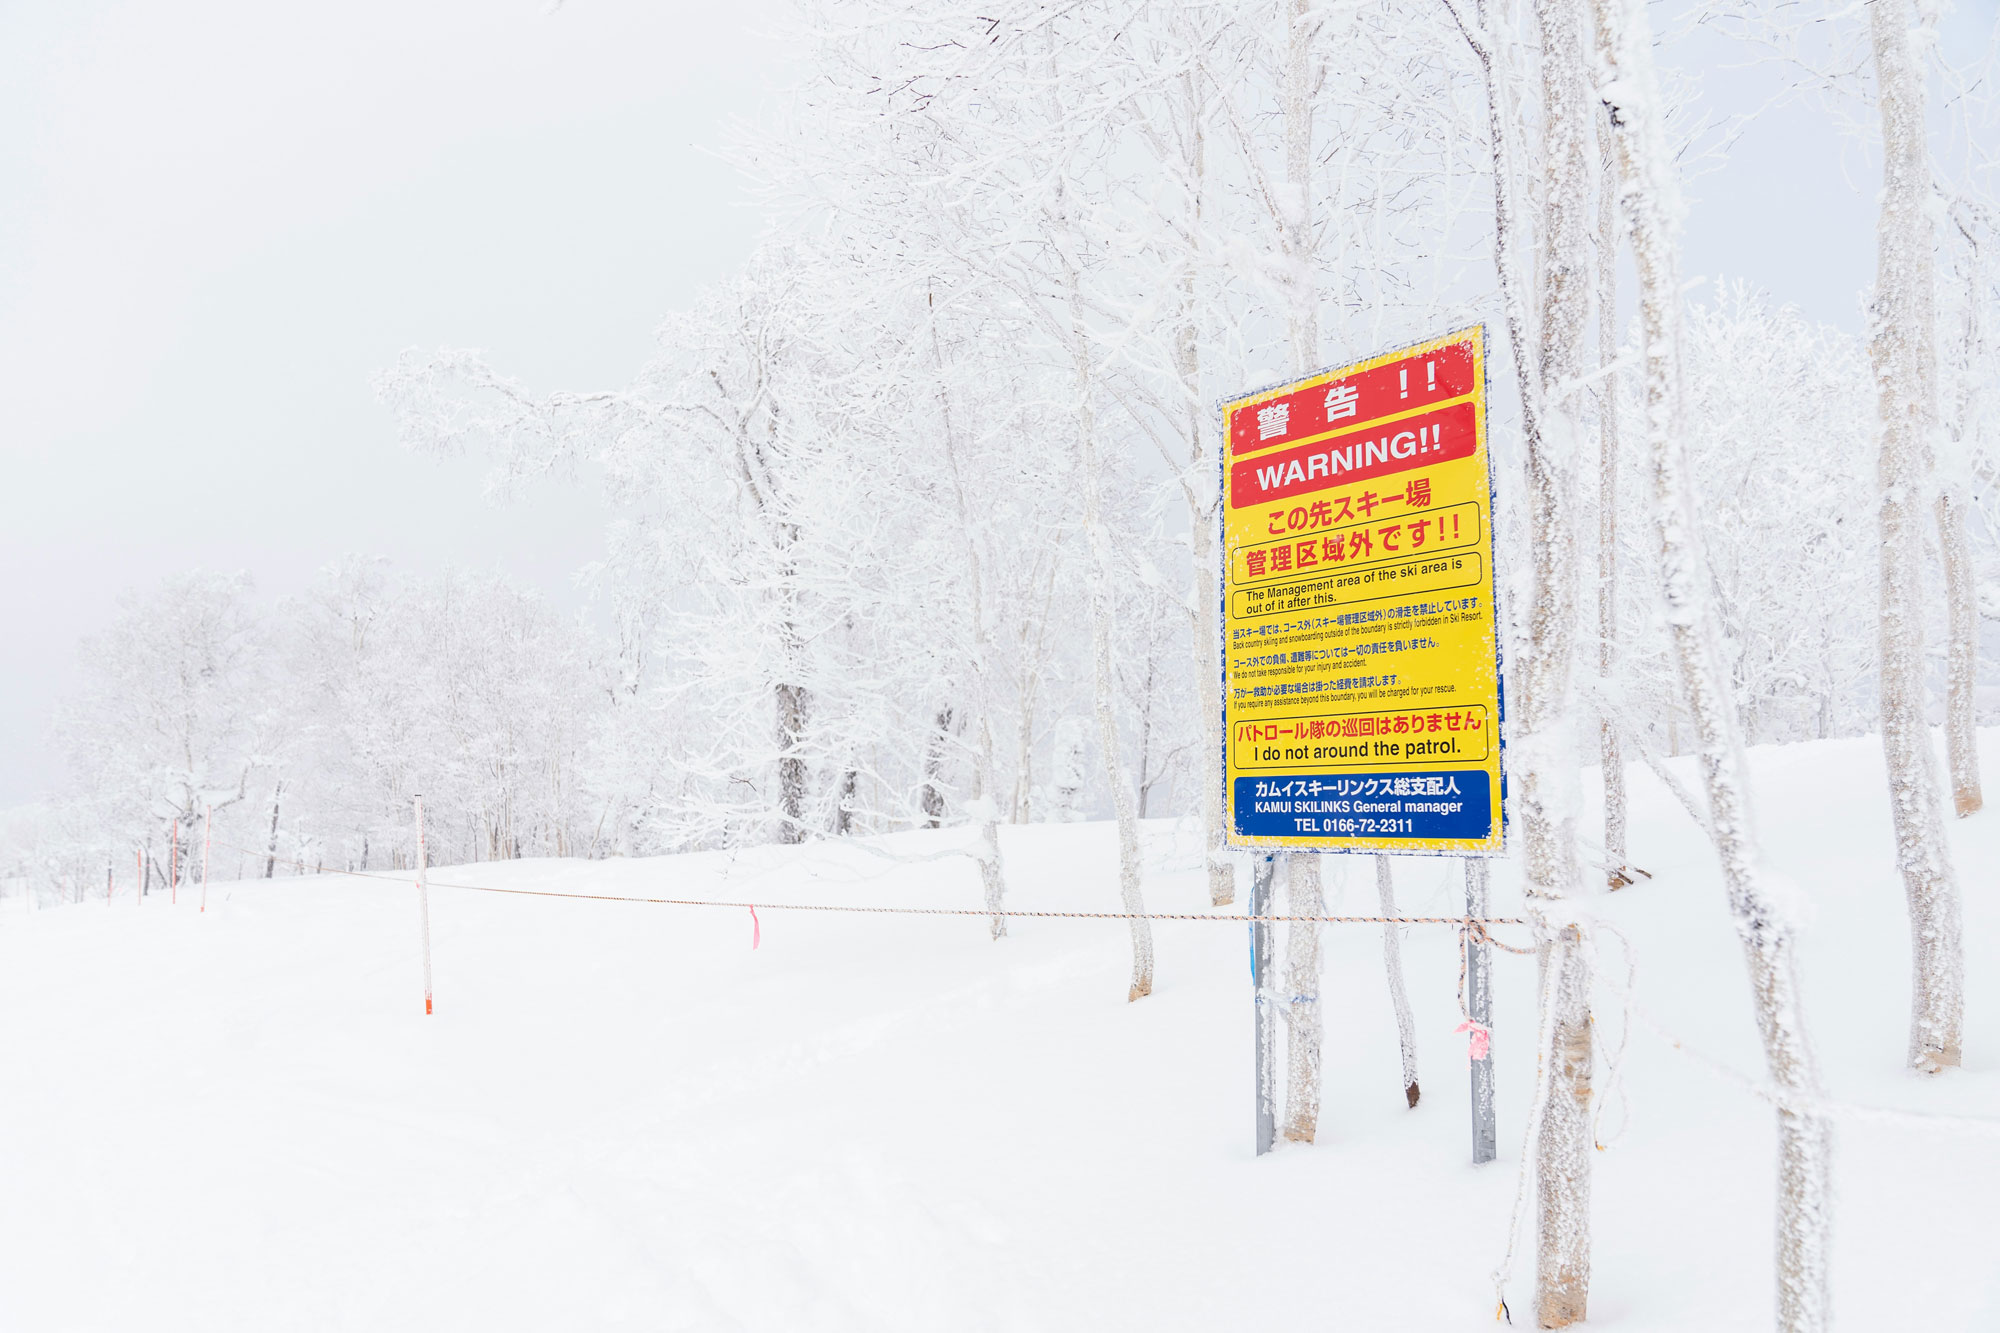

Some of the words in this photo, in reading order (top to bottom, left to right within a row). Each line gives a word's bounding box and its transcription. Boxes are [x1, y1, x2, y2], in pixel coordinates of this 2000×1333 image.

[1256, 424, 1440, 491] WARNING!!
[1267, 478, 1431, 535] この先スキー場
[1246, 513, 1459, 577] 管理区域外です!!
[1246, 590, 1265, 601] The
[1267, 578, 1333, 598] Management
[1336, 575, 1361, 587] area
[1364, 571, 1375, 583] of
[1379, 569, 1397, 581] the
[1400, 564, 1417, 578] ski
[1421, 562, 1447, 575] area
[1452, 558, 1462, 570] is
[1246, 603, 1262, 614] out
[1265, 600, 1275, 611] of
[1278, 599, 1284, 609] it
[1287, 597, 1310, 608] after
[1314, 592, 1337, 604] this.
[1233, 641, 1244, 650] Back
[1245, 639, 1263, 649] country
[1264, 637, 1278, 647] skiing
[1279, 635, 1288, 644] and
[1289, 631, 1324, 643] snowboarding
[1325, 628, 1343, 638] outside
[1351, 626, 1360, 635] the
[1361, 622, 1386, 634] boundary
[1394, 620, 1413, 631] strictly
[1414, 616, 1441, 627] forbidden
[1450, 613, 1460, 623] Ski
[1461, 611, 1482, 621] Resort.
[1233, 671, 1240, 679] We
[1241, 670, 1247, 678] do
[1257, 668, 1266, 677] take
[1267, 665, 1295, 677] responsible
[1304, 663, 1316, 674] your
[1317, 662, 1331, 672] injury
[1332, 660, 1342, 669] and
[1343, 658, 1367, 668] accident.
[1238, 701, 1246, 711] you
[1247, 699, 1263, 710] require
[1264, 699, 1273, 708] any
[1274, 696, 1299, 706] assistance
[1301, 694, 1319, 705] beyond
[1320, 693, 1330, 702] this
[1331, 691, 1357, 703] boundary,
[1358, 691, 1368, 702] you
[1369, 689, 1377, 698] will
[1378, 688, 1386, 698] be
[1387, 686, 1410, 698] charged
[1411, 685, 1419, 695] for
[1420, 686, 1433, 696] your
[1435, 684, 1456, 694] rescue.
[1238, 711, 1481, 742] パトロール隊の巡回はありません
[1255, 746, 1258, 761] I
[1263, 746, 1280, 760] do
[1285, 745, 1309, 760] not
[1313, 741, 1368, 759] around
[1374, 740, 1400, 756] the
[1405, 737, 1461, 759] patrol.
[1255, 776, 1461, 797] カムイスキーリンクス総支配人
[1255, 801, 1292, 813] KAMUI
[1294, 800, 1350, 813] SKILINKS
[1353, 800, 1401, 813] General
[1404, 801, 1463, 816] manager
[1294, 818, 1320, 832] TEL
[1323, 818, 1413, 832] 0166-72-2311
